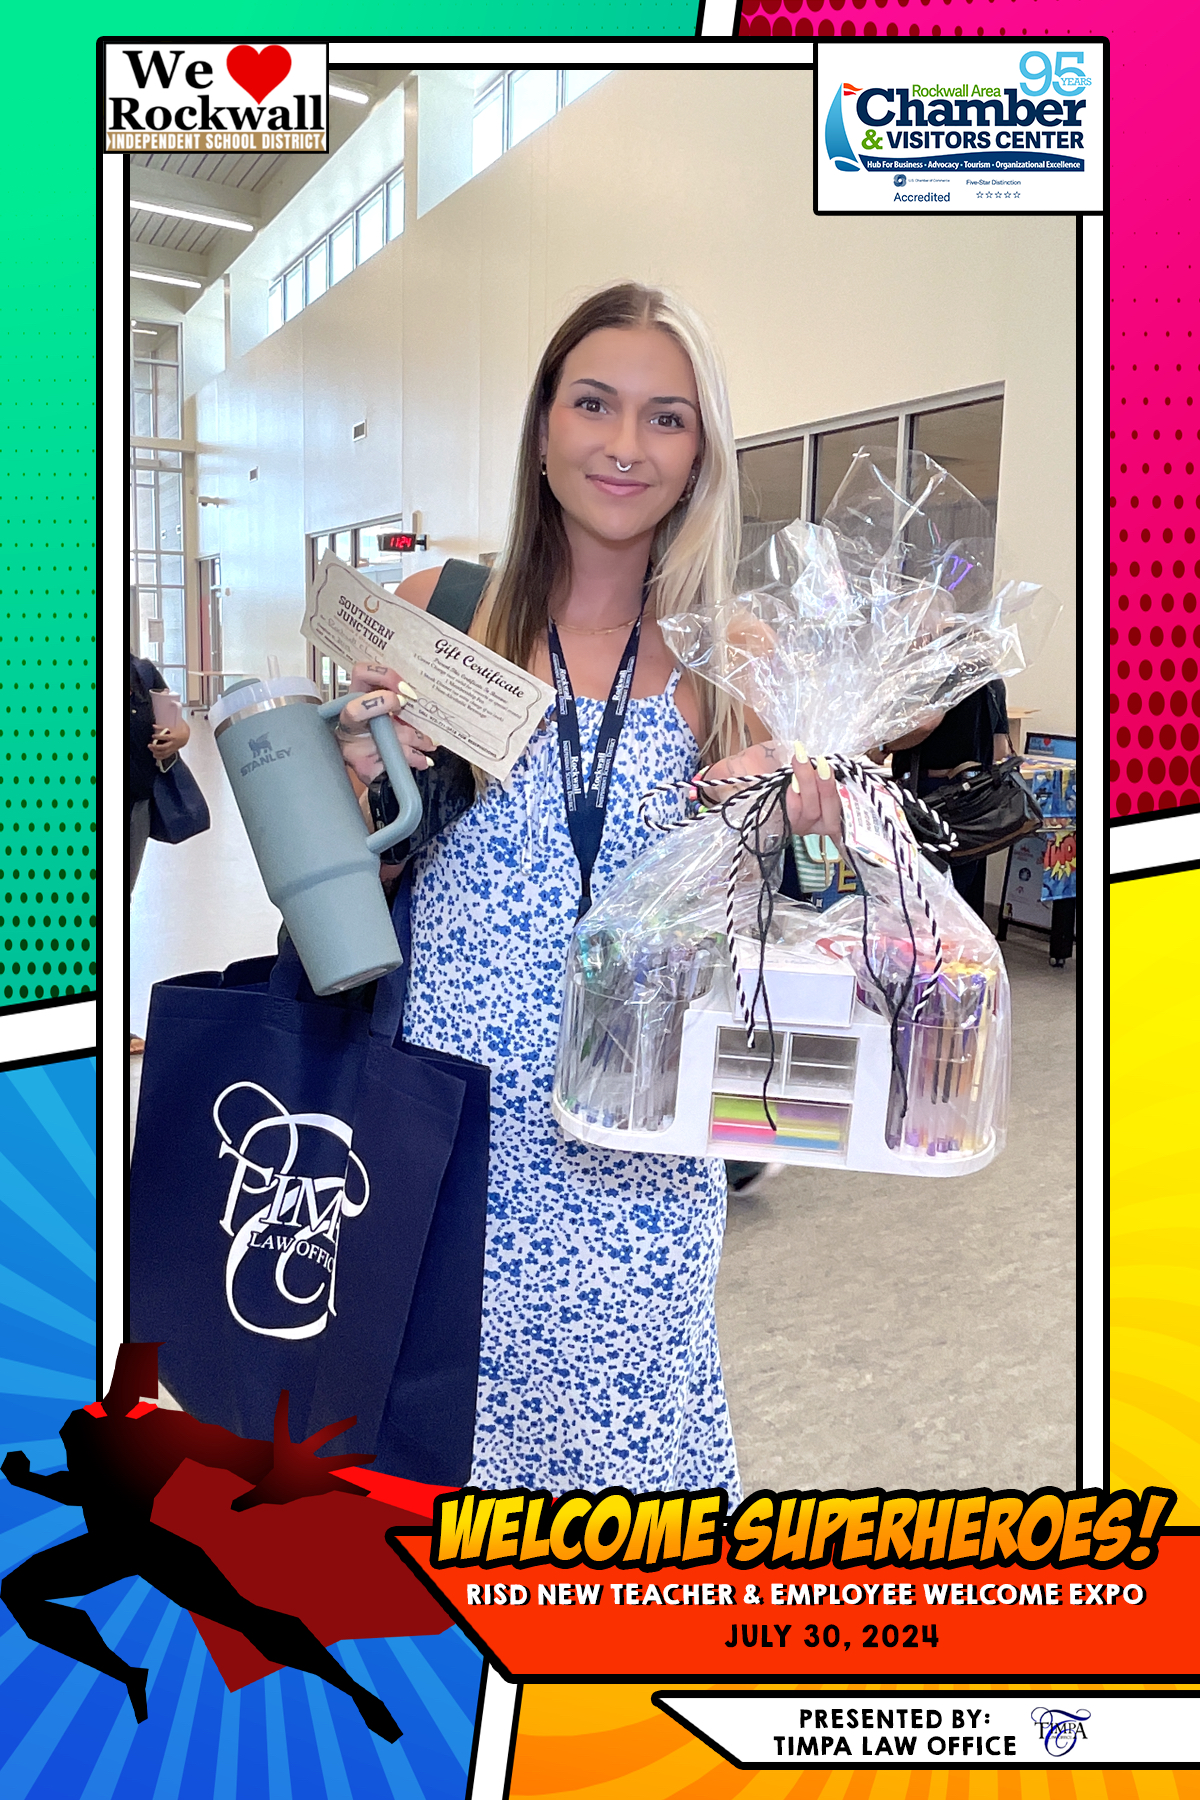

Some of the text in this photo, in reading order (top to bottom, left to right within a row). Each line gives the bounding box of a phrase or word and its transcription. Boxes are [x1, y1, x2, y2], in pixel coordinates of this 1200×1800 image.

[337, 608, 388, 651] JUNCTION
[339, 595, 395, 641] SOUTHERN
[434, 638, 462, 660] Gift
[462, 655, 525, 698] Certificate
[559, 668, 572, 700] Rockwall
[612, 670, 627, 700] Rockwall
[240, 747, 292, 776] STANLEY
[571, 756, 581, 794] Rockwall
[591, 752, 606, 790] Rockwall
[250, 1231, 293, 1251] LAW
